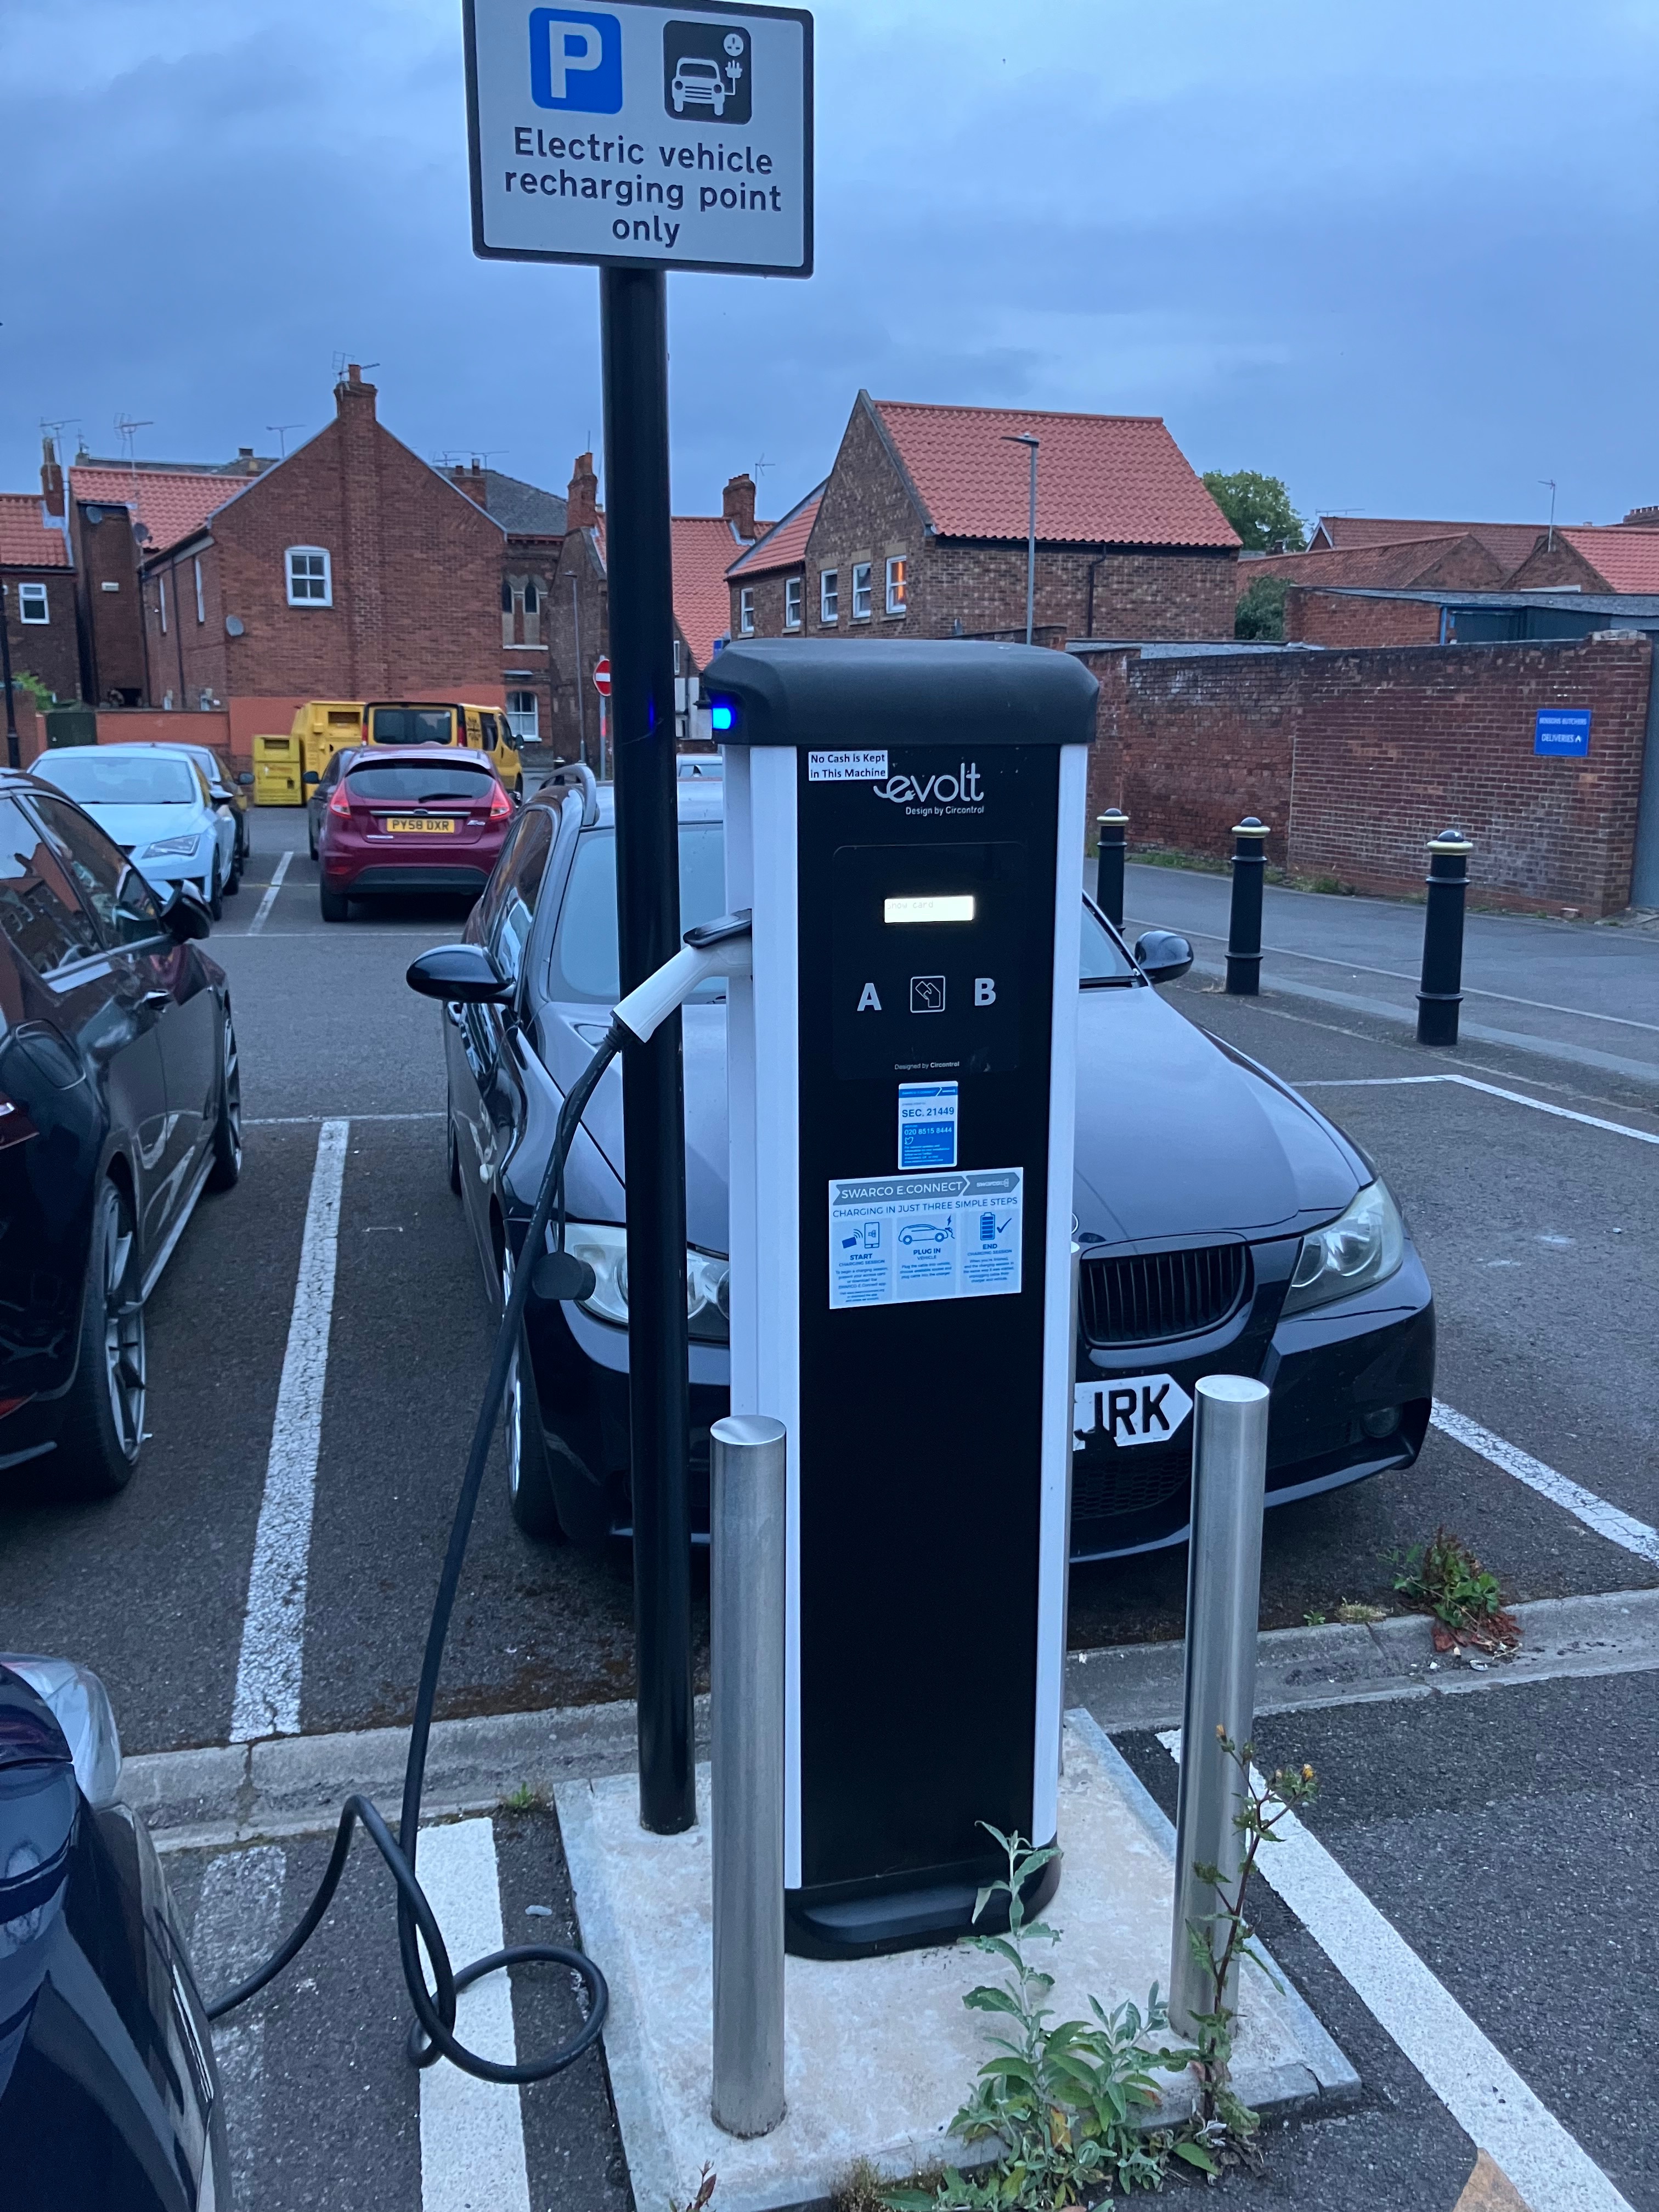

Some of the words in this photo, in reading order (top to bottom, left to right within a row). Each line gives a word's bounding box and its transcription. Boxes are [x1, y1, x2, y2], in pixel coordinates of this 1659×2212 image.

[549, 20, 602, 99] P
[515, 127, 644, 165] Electric
[659, 143, 772, 174] vehicle
[505, 170, 683, 210] recharging
[700, 183, 781, 212] point
[612, 215, 680, 248] only
[811, 755, 825, 764] No
[827, 754, 850, 763] Cash
[863, 753, 885, 764] Kept
[822, 769, 842, 778] This
[845, 768, 885, 778] Machine
[873, 763, 984, 803] evolt
[906, 807, 932, 816] Design
[934, 806, 943, 816] by
[945, 805, 984, 815] Circontrol
[392, 820, 422, 830] PY58
[427, 821, 449, 831] DXR
[857, 983, 882, 1011] A
[974, 978, 996, 1006] B
[902, 1109, 924, 1118] SEC.
[927, 1107, 955, 1116] 21449
[842, 1184, 893, 1199] SWARCO
[896, 1181, 963, 1195] E.CONNECT
[833, 1207, 883, 1217] CHARGING
[898, 1204, 921, 1213] JUST
[924, 1202, 952, 1210] THREE
[955, 1199, 988, 1208] SIMPLE
[990, 1197, 1018, 1206] STEPS
